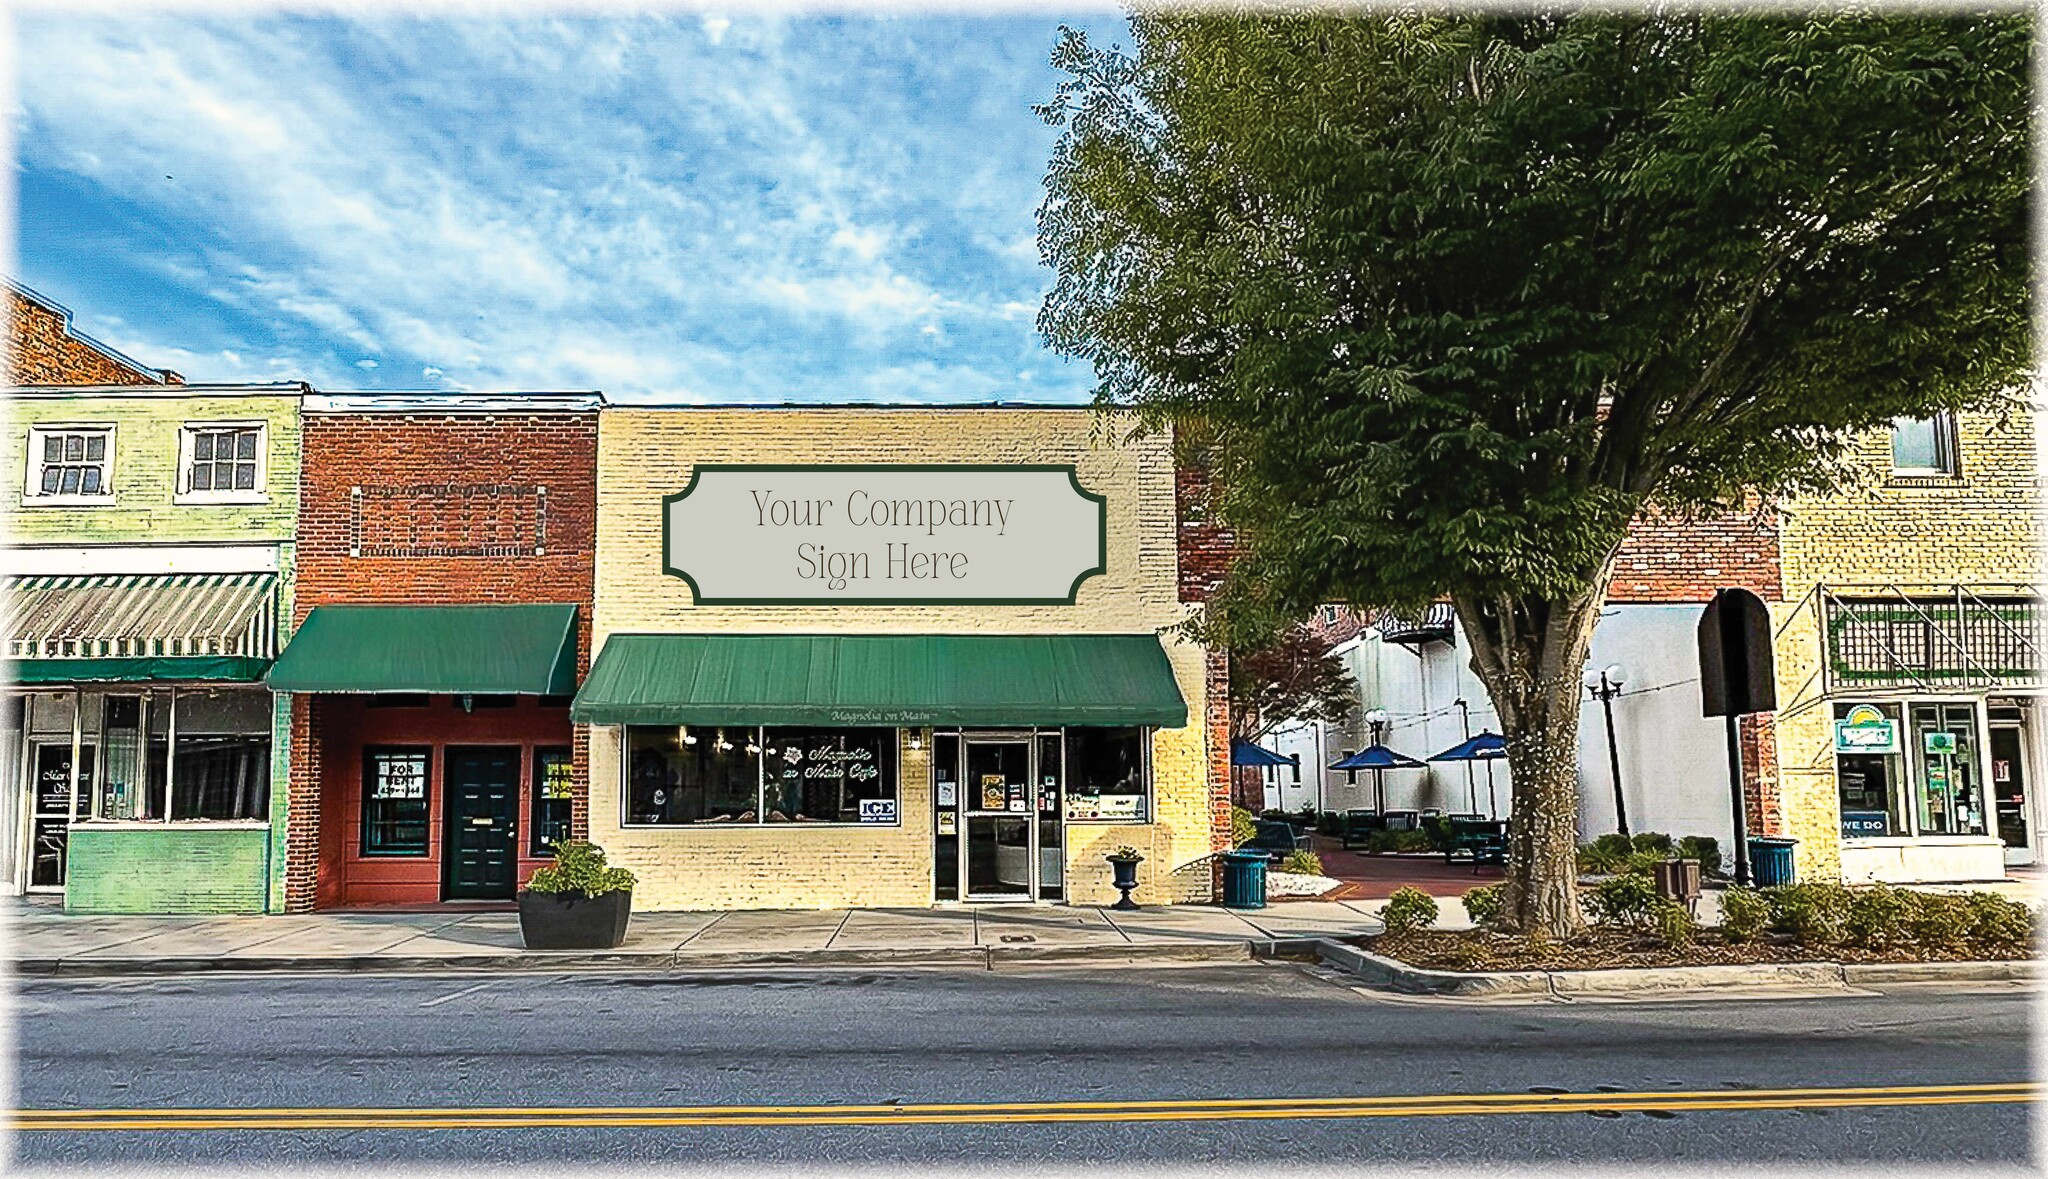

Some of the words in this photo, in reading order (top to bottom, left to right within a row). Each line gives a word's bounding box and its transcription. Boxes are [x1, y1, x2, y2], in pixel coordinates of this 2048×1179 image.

[749, 489, 833, 527] Your
[847, 489, 1015, 536] Company
[796, 542, 872, 591] Sign
[885, 542, 969, 580] Here
[831, 709, 882, 726] Magnolia
[884, 712, 898, 721] on
[900, 710, 930, 721] Main
[390, 764, 414, 775] FOR
[862, 802, 894, 815] ICE
[1842, 821, 1860, 829] WE
[1863, 821, 1884, 829] DO
